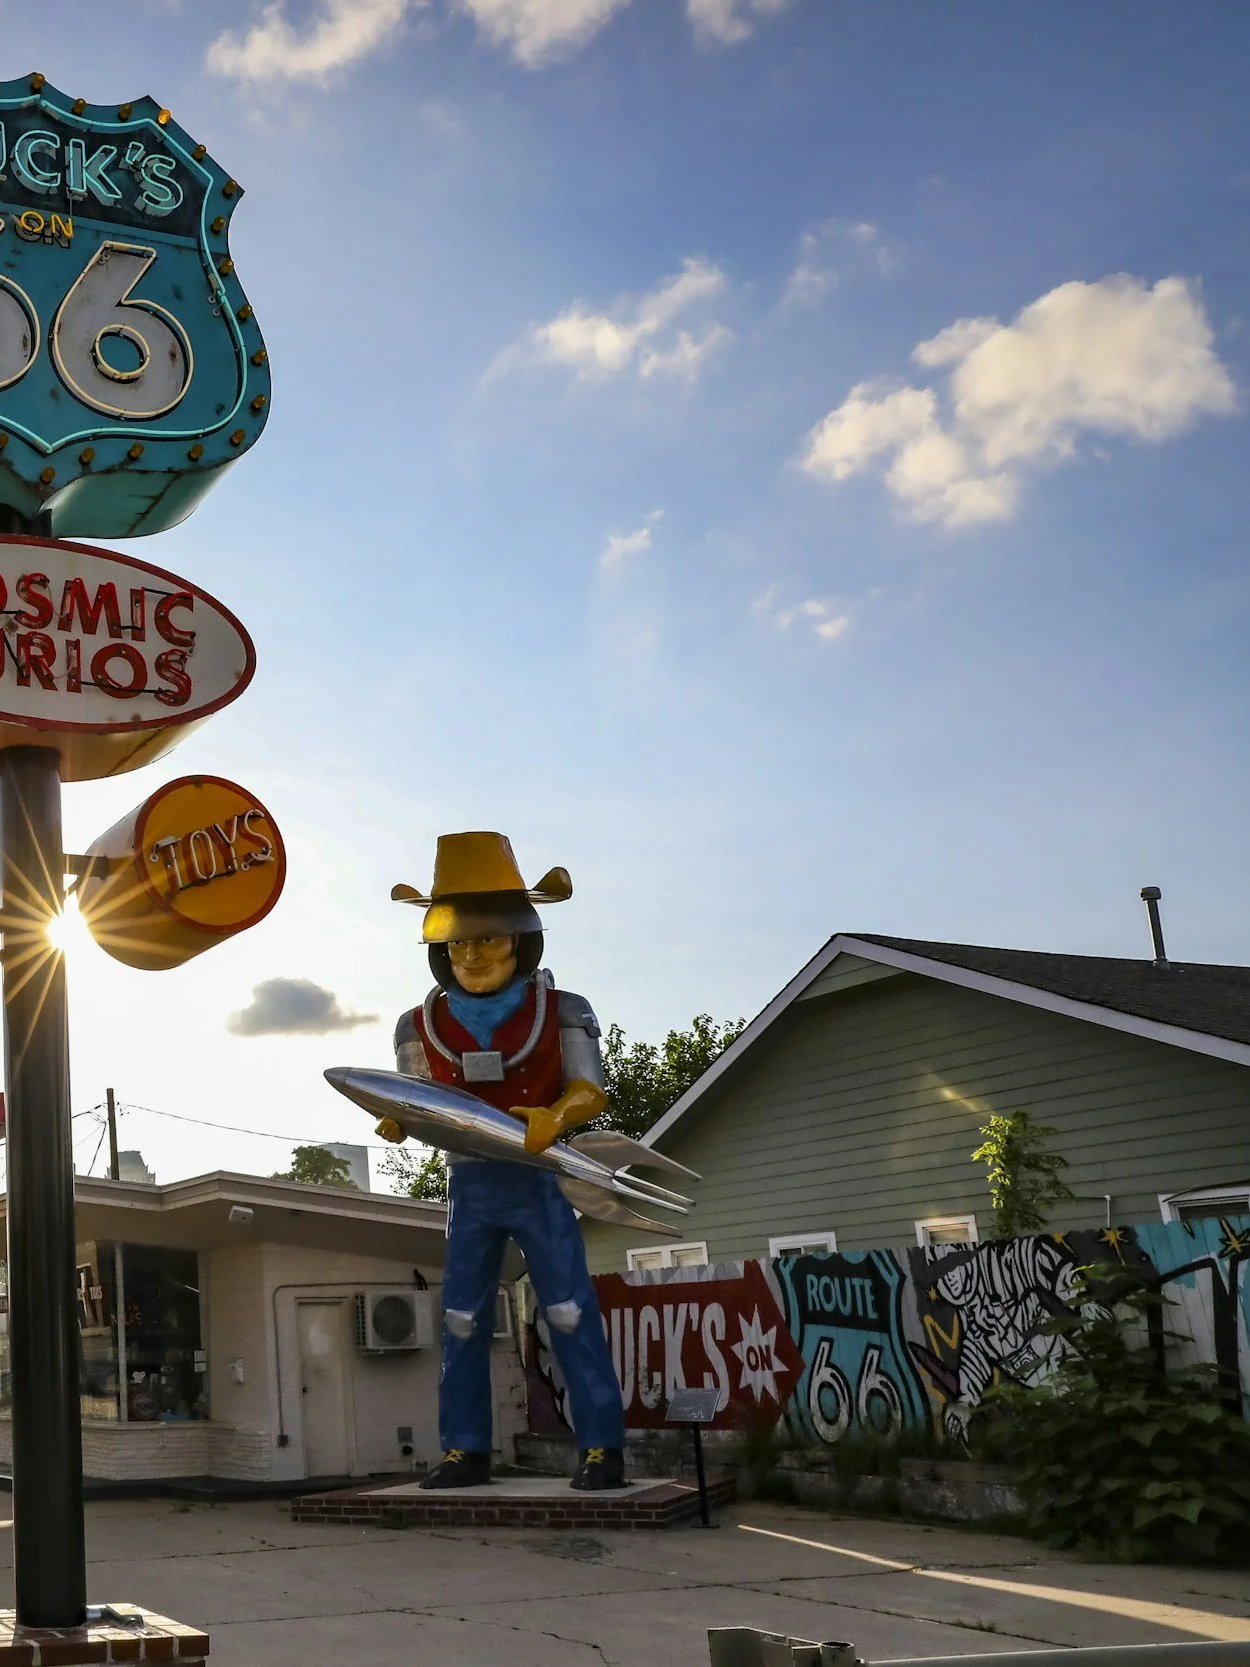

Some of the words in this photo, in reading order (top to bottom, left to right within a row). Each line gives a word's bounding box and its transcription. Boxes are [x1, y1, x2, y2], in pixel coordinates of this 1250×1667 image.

[14, 210, 73, 248] ON
[152, 809, 274, 894] TOYS
[806, 1273, 879, 1320] ROUTE
[599, 1302, 730, 1412] UCK'S
[746, 1345, 773, 1372] ON
[808, 1337, 904, 1445] 66
